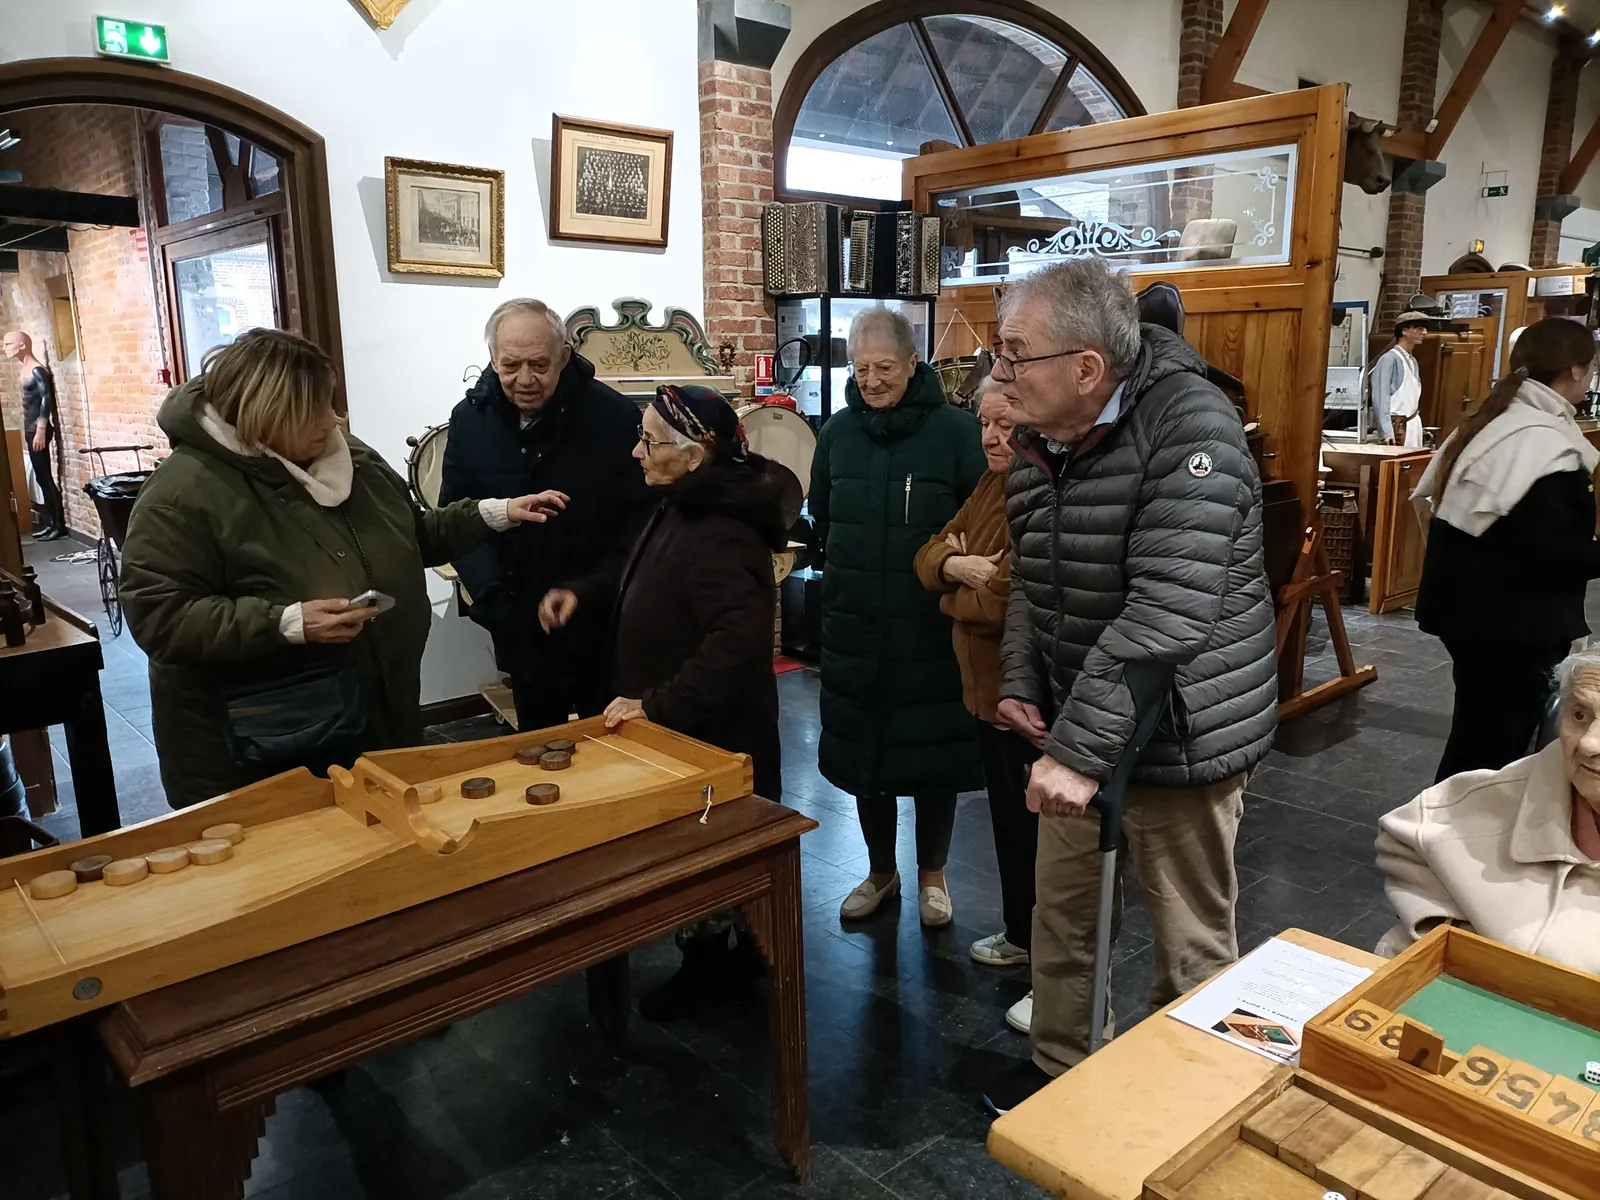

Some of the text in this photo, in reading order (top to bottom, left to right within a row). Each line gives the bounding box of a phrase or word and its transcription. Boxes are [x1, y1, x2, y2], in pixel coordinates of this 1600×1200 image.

[1344, 1009, 1379, 1032] 9
[1379, 1025, 1403, 1050] 8
[1459, 1056, 1499, 1086] 6
[1496, 1072, 1541, 1110] 5
[1547, 1091, 1580, 1126] 4
